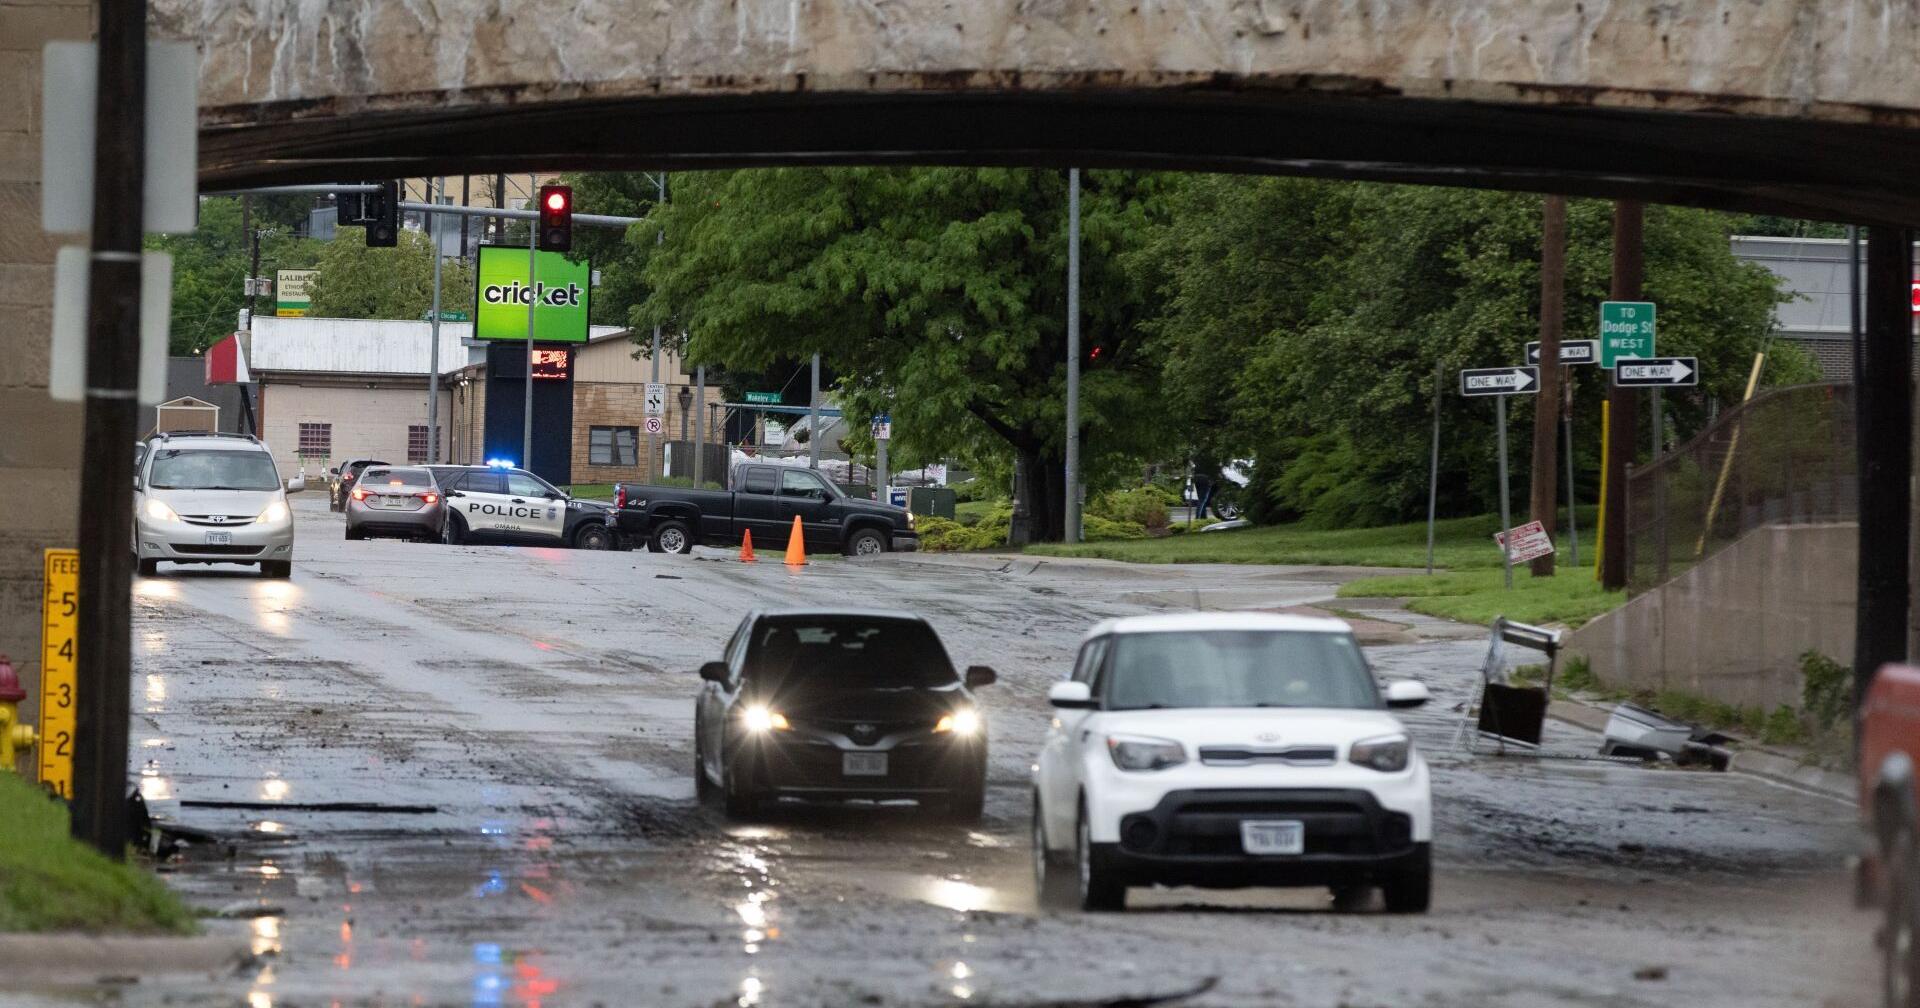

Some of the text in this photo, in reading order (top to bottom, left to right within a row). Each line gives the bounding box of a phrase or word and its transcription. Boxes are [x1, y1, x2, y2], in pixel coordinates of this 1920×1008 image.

[483, 280, 581, 307] cricket
[1620, 307, 1636, 318] TO
[1603, 320, 1653, 334] Dodge St
[1609, 338, 1645, 349] WEST
[1568, 347, 1589, 357] WAY
[1624, 366, 1674, 378] ONE WAY
[1470, 375, 1518, 387] ONE WAY
[469, 502, 541, 519] POLICE
[494, 523, 521, 531] OMAHA
[52, 558, 79, 574] FEE
[61, 591, 76, 618] 5
[58, 637, 73, 663] 4
[57, 683, 71, 708] 3
[56, 731, 70, 757] 2
